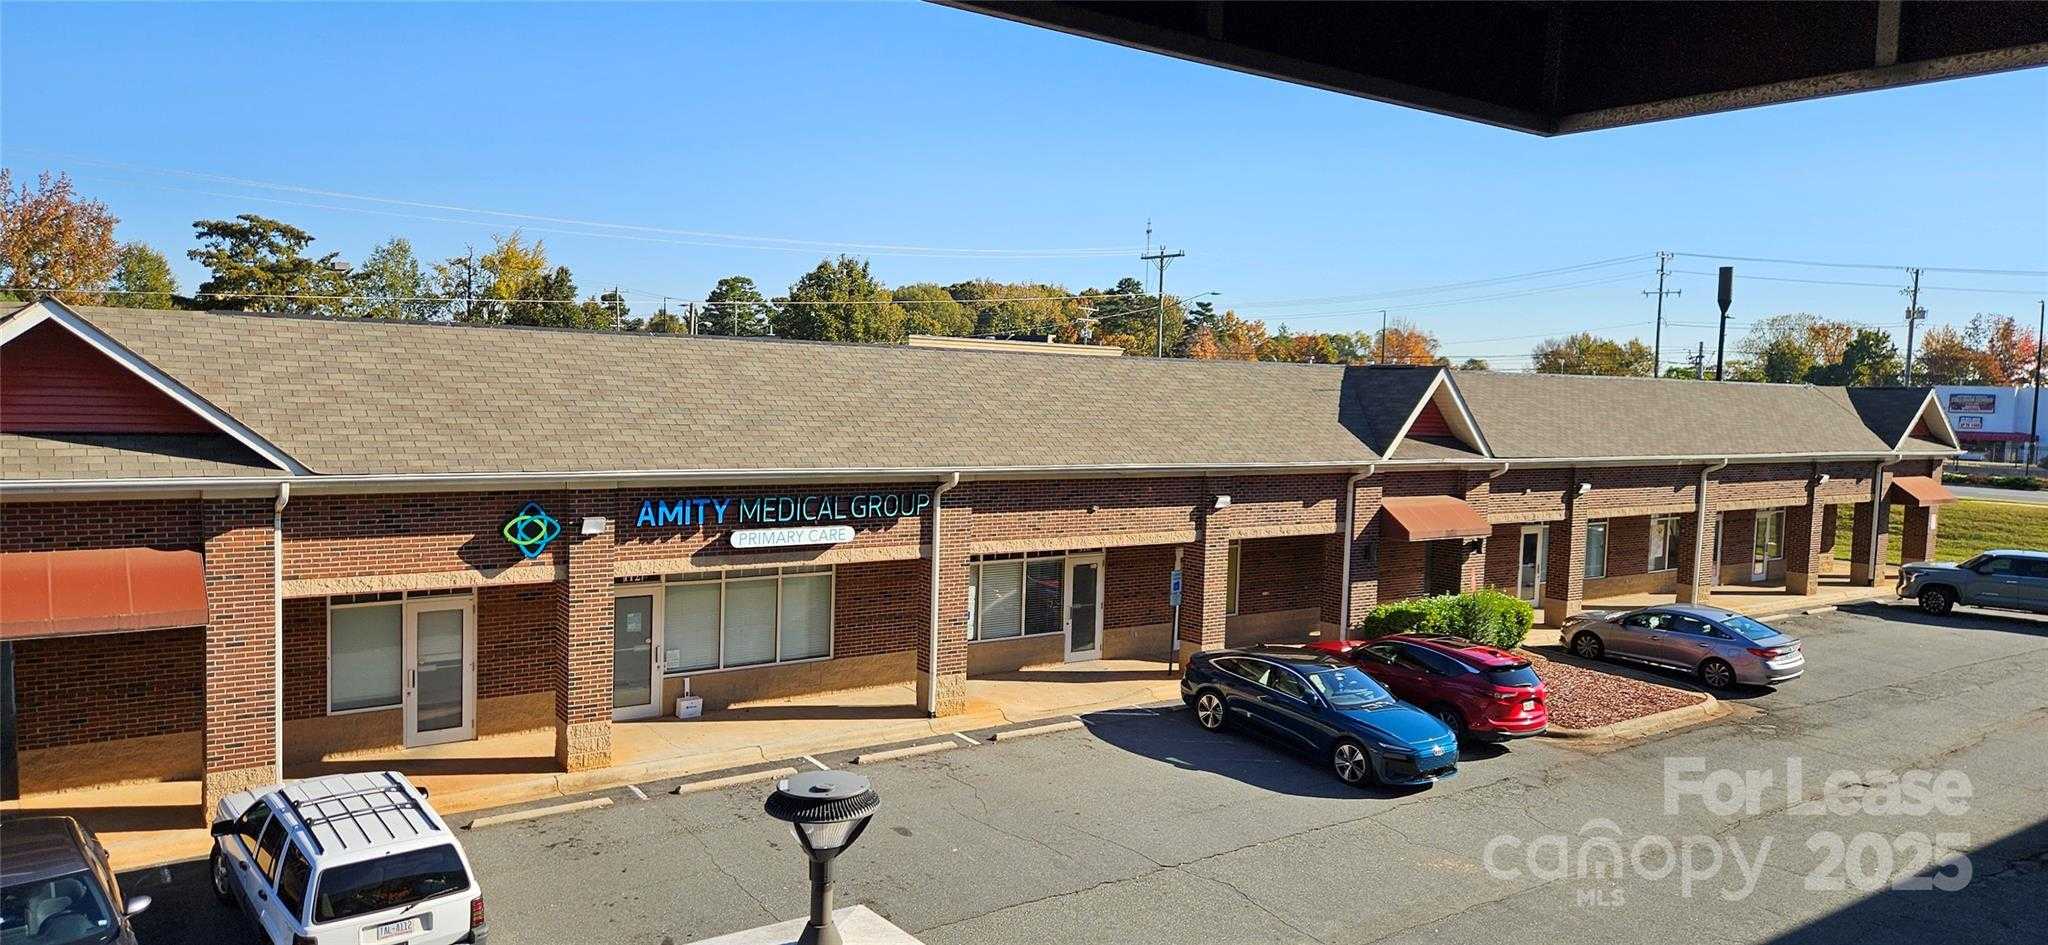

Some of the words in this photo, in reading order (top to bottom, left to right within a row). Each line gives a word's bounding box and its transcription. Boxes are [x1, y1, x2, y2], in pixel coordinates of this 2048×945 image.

[636, 498, 730, 527] AMITY
[739, 495, 846, 523] MEDICAL
[851, 493, 930, 519] GROUP
[739, 530, 802, 545] PRIMARY
[808, 528, 846, 542] CARE
